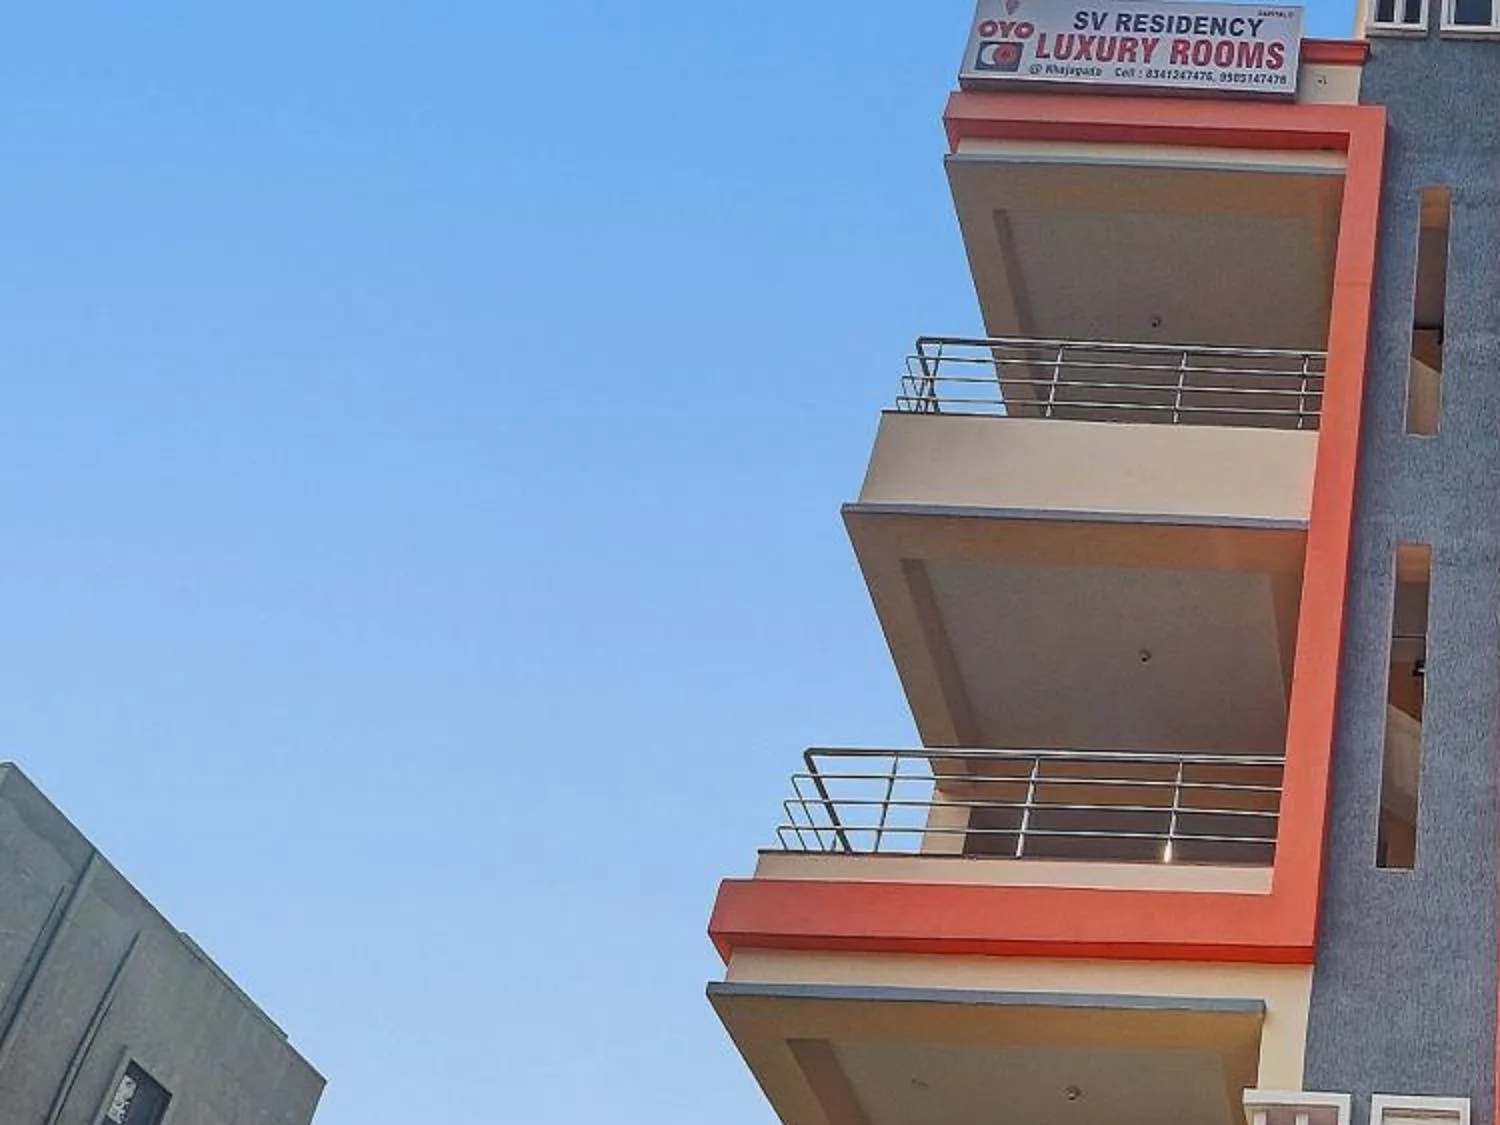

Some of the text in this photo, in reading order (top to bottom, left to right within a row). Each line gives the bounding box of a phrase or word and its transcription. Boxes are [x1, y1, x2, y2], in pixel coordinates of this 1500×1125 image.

[978, 20, 1034, 39] OYO
[1073, 11, 1264, 37] SV RESIDENCY
[1035, 32, 1285, 69] LUXURY ROOMS
